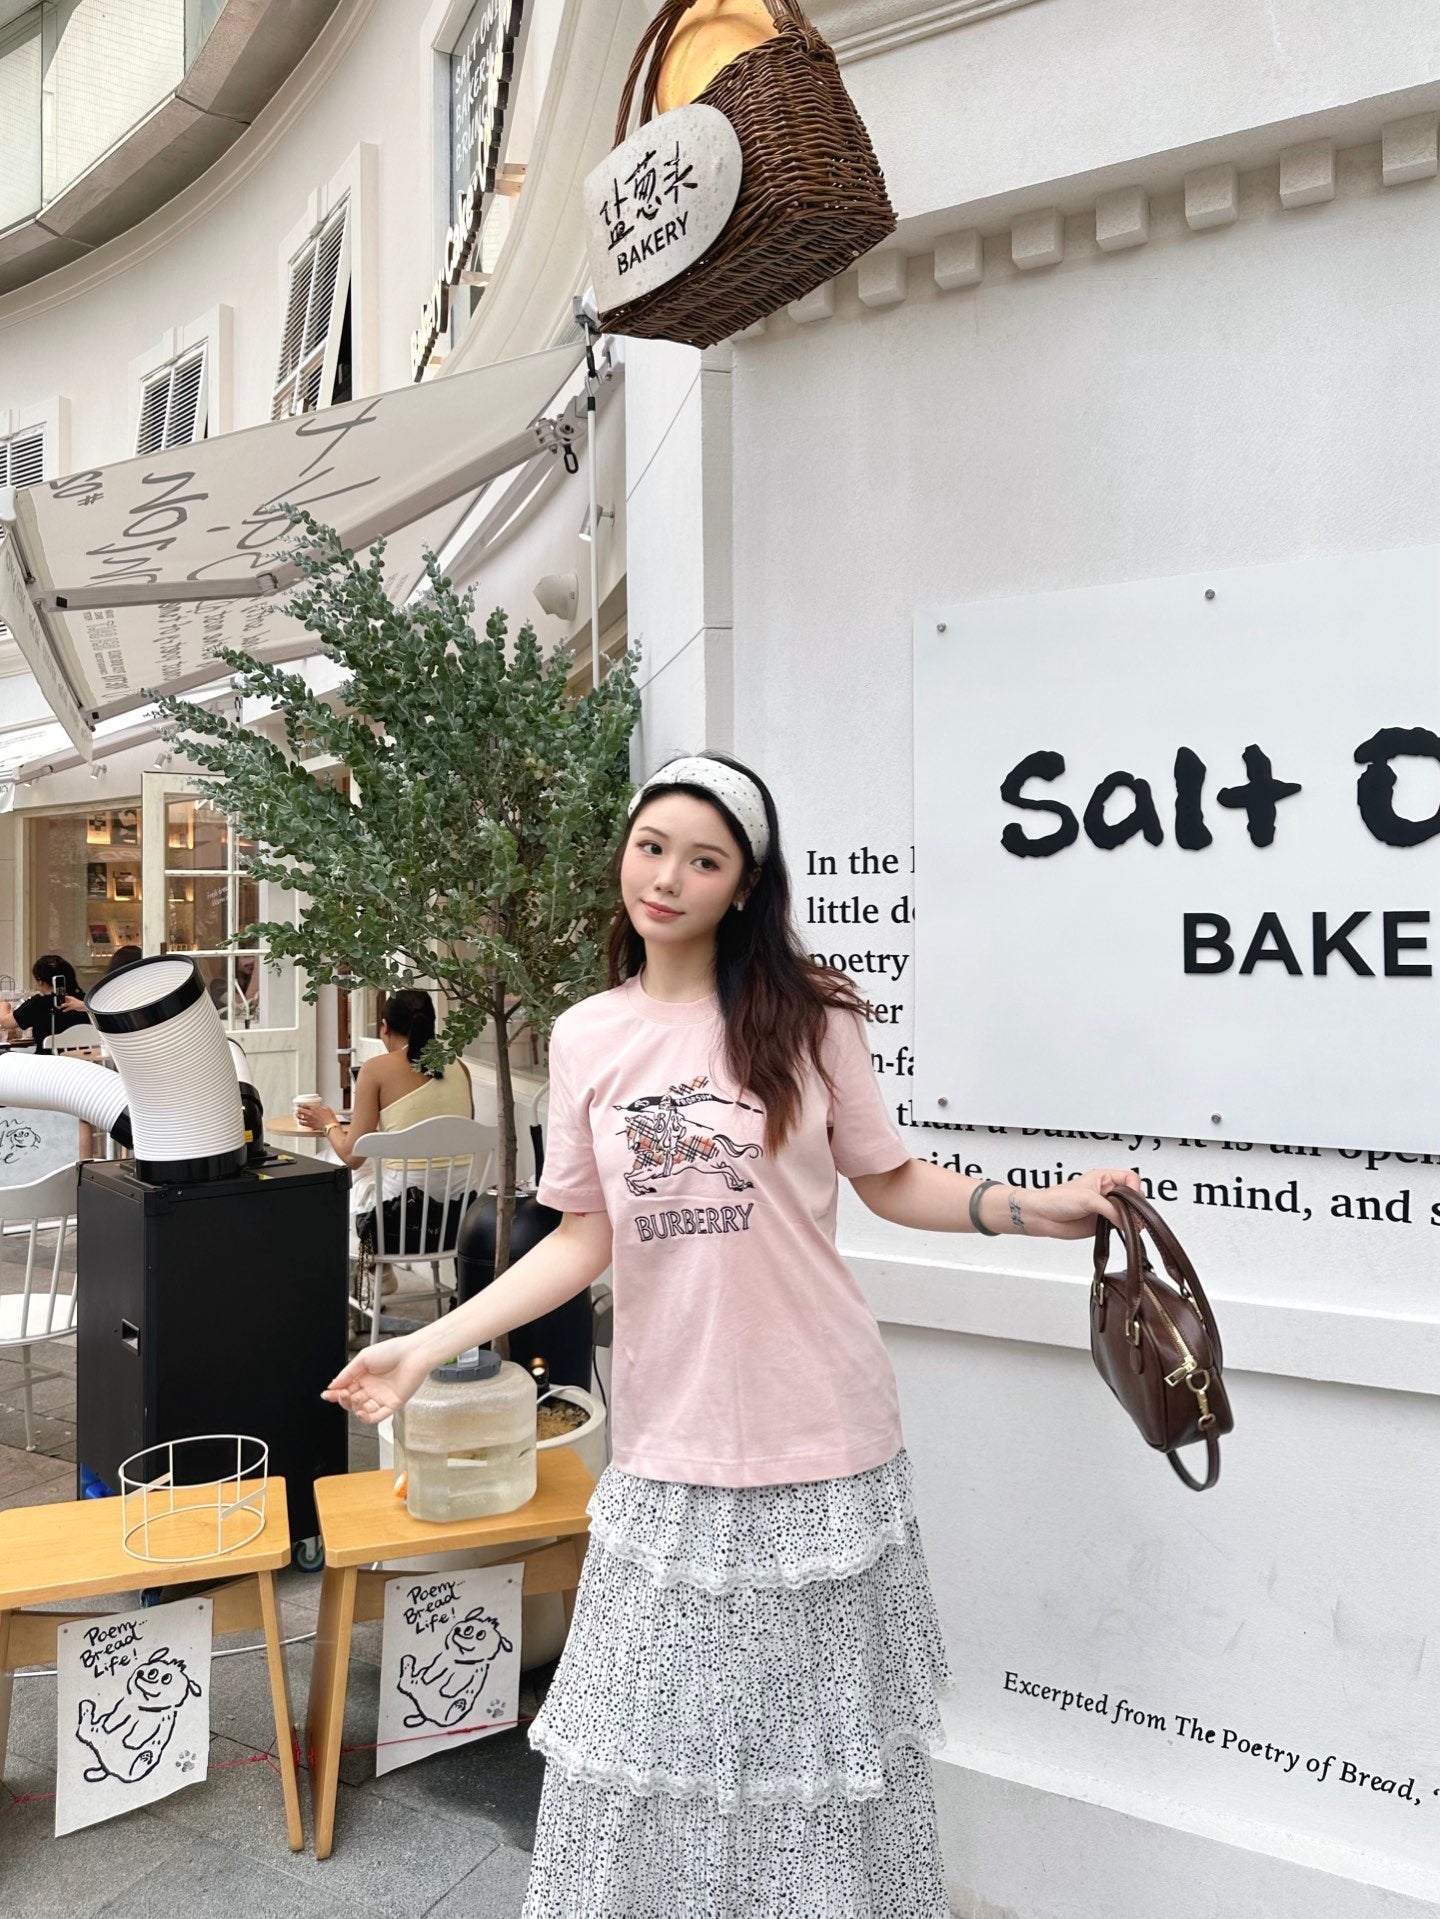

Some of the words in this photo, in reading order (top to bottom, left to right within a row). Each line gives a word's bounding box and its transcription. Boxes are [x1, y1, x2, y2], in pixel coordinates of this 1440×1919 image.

[455, 94, 490, 172] BRUNC
[617, 211, 688, 275] BAKERY
[1000, 744, 1302, 859] Salt
[807, 851, 838, 875] In
[848, 847, 899, 874] the
[807, 896, 879, 923] little
[1184, 911, 1432, 978] BAKE
[1131, 1167, 1178, 1202] he
[1193, 1177, 1312, 1221] mind,
[1330, 1190, 1412, 1224] and
[634, 1203, 754, 1242] BURBERRY
[403, 1586, 461, 1625] Bread
[416, 1606, 456, 1635] Life!
[80, 1628, 143, 1668] Bread
[94, 1648, 138, 1679] Life!
[1003, 1671, 1109, 1715] Excerpted
[1111, 1700, 1167, 1731] from
[1175, 1715, 1216, 1744] The
[1221, 1729, 1300, 1772] Poetry
[1306, 1755, 1337, 1782] of
[1339, 1761, 1421, 1806] Bread,
